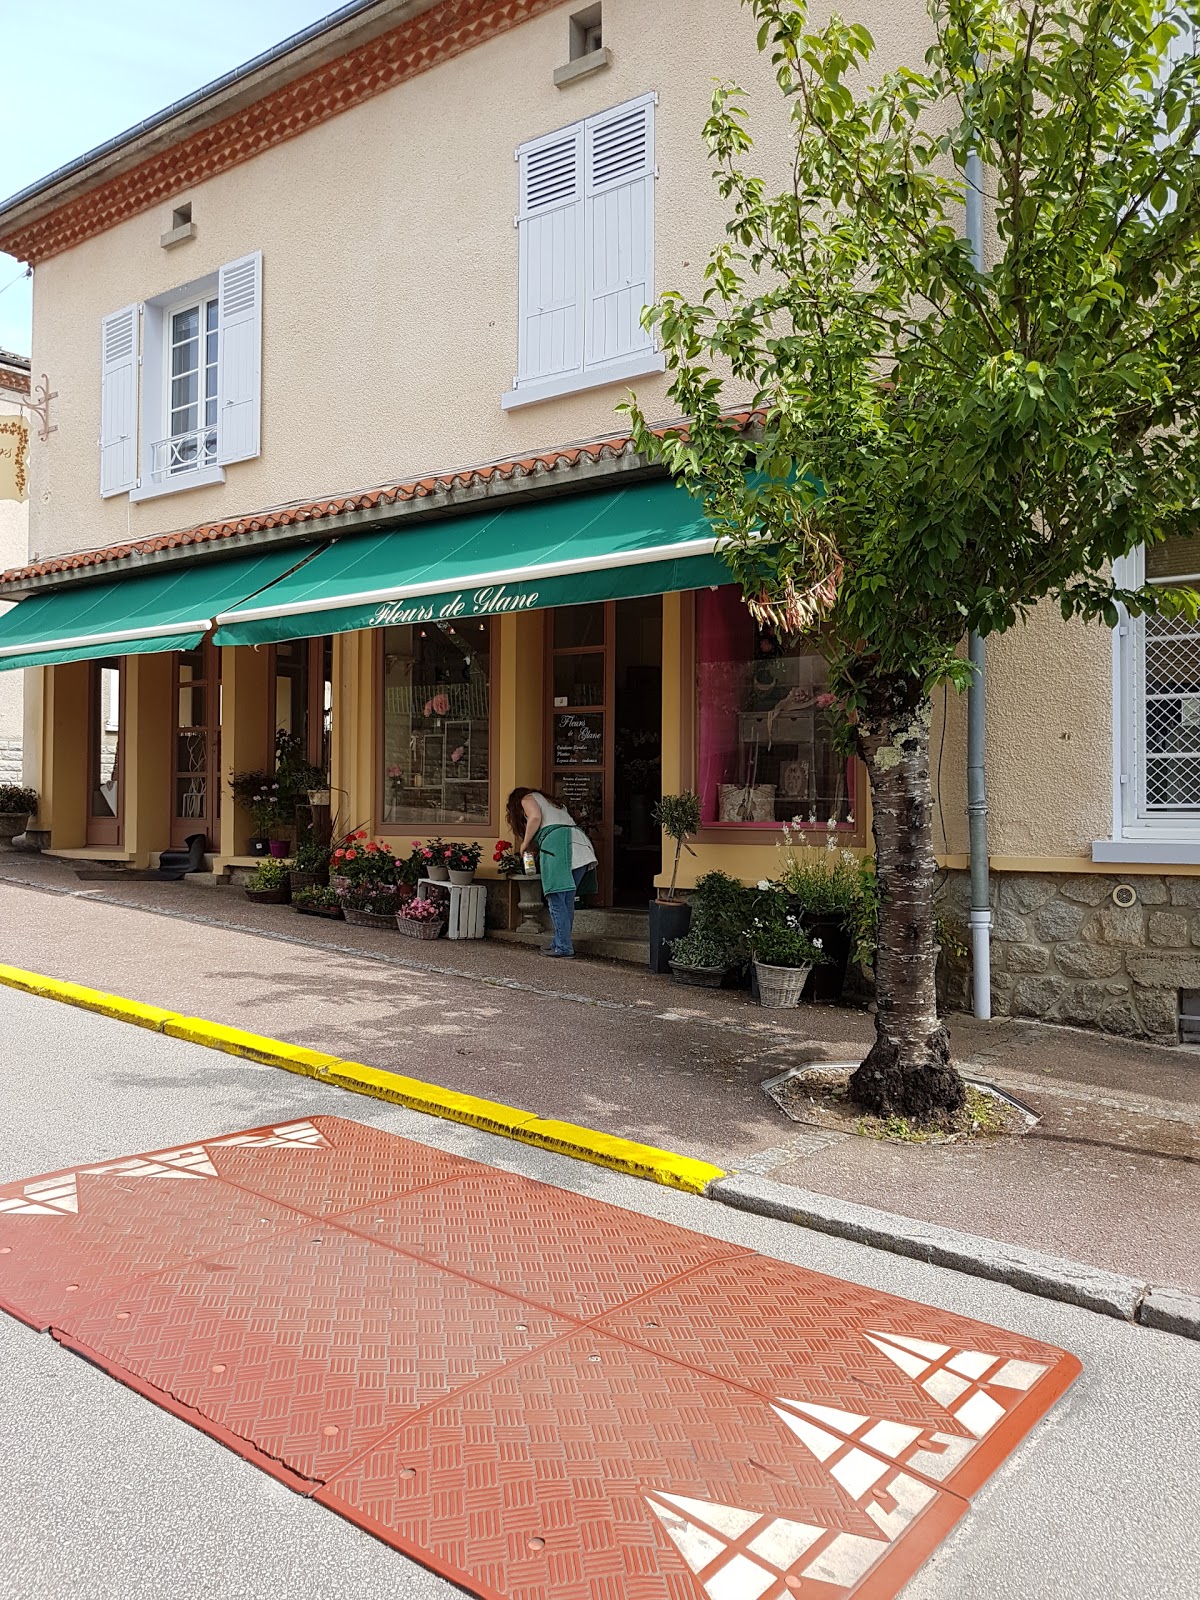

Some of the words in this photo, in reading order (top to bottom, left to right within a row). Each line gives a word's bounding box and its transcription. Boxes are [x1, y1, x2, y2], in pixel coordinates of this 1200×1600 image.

[369, 600, 435, 626] Fleurs
[439, 594, 466, 617] de
[473, 585, 539, 614] Glane
[559, 715, 586, 727] Fleurs
[578, 727, 601, 741] Glane
